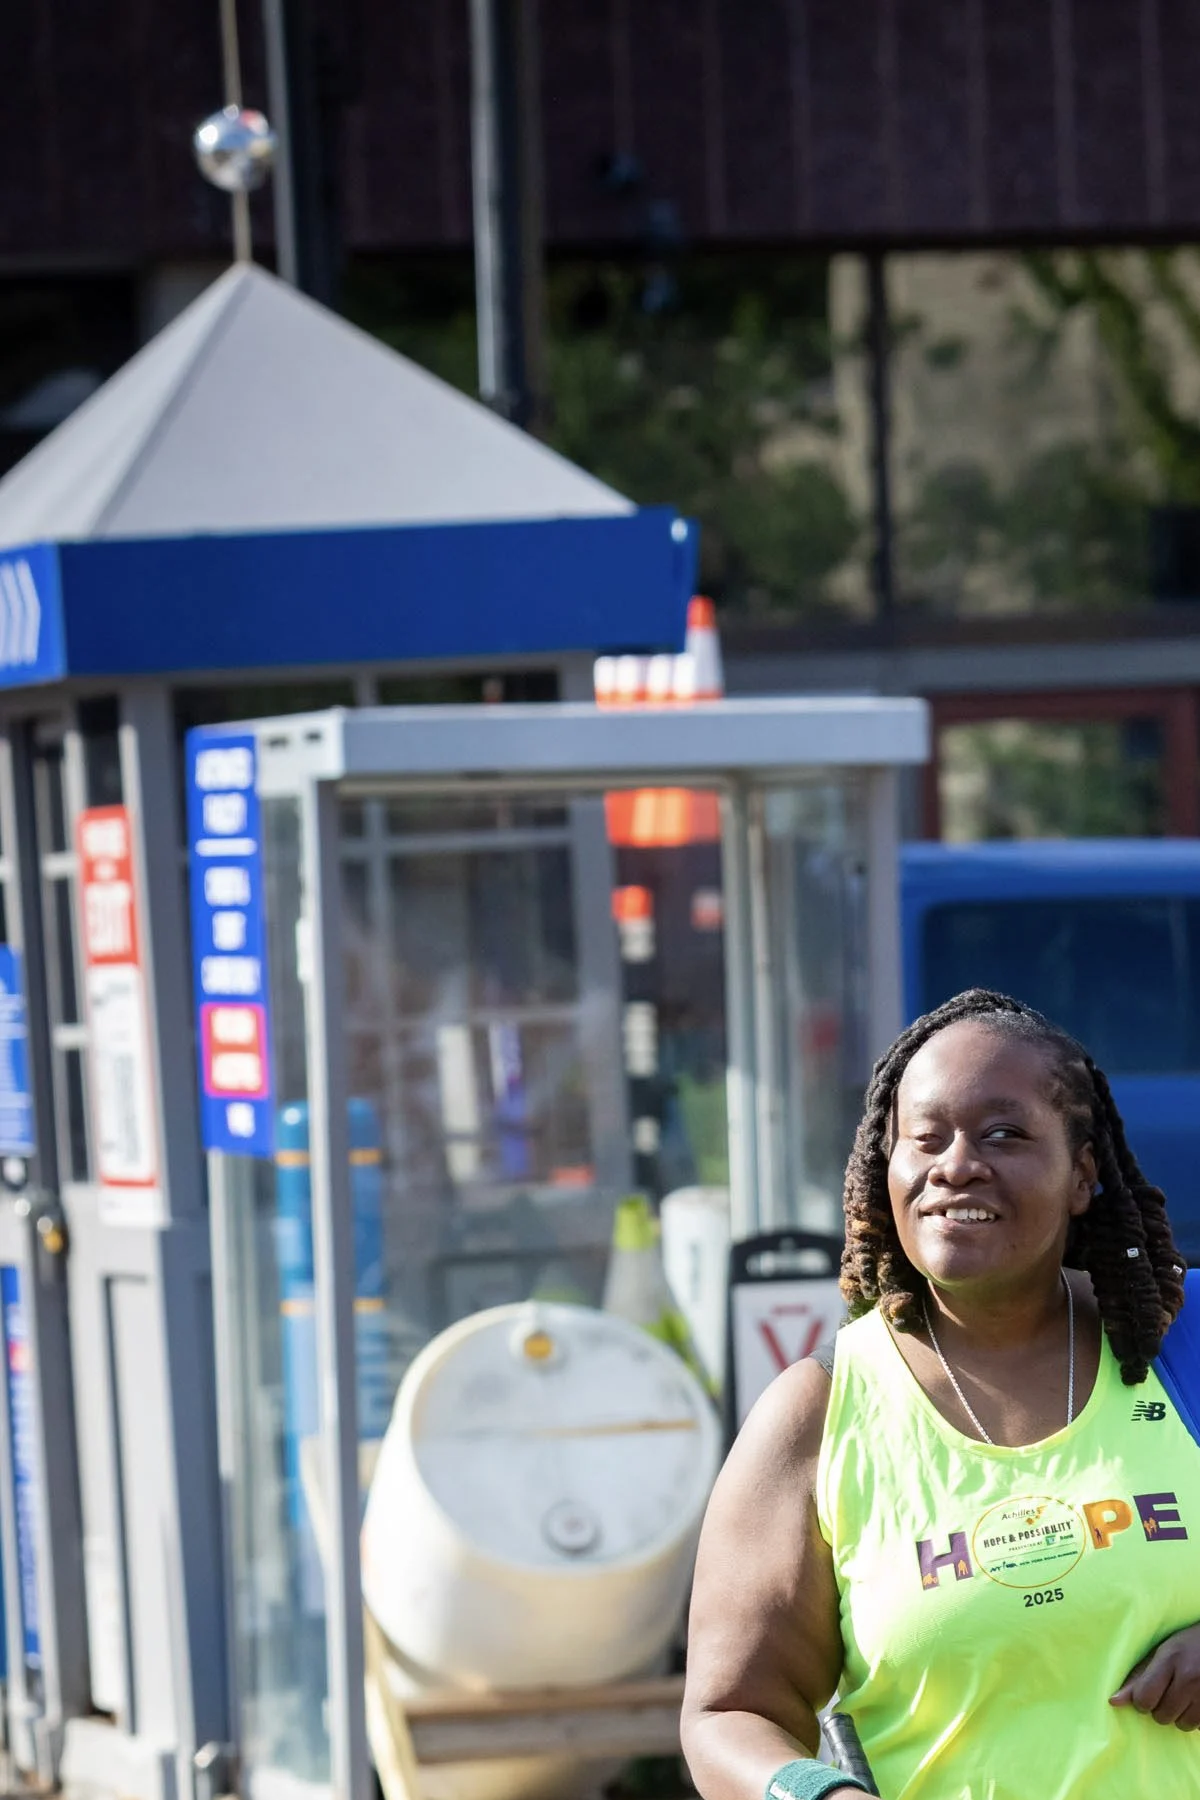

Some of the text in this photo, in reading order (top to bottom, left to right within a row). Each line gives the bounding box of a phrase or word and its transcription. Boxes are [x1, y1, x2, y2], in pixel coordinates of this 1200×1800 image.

[1001, 1508, 1036, 1521] Achilles
[983, 1534, 1008, 1548] HOPE
[1008, 1533, 1017, 1543] &
[1023, 1588, 1065, 1608] 2025
